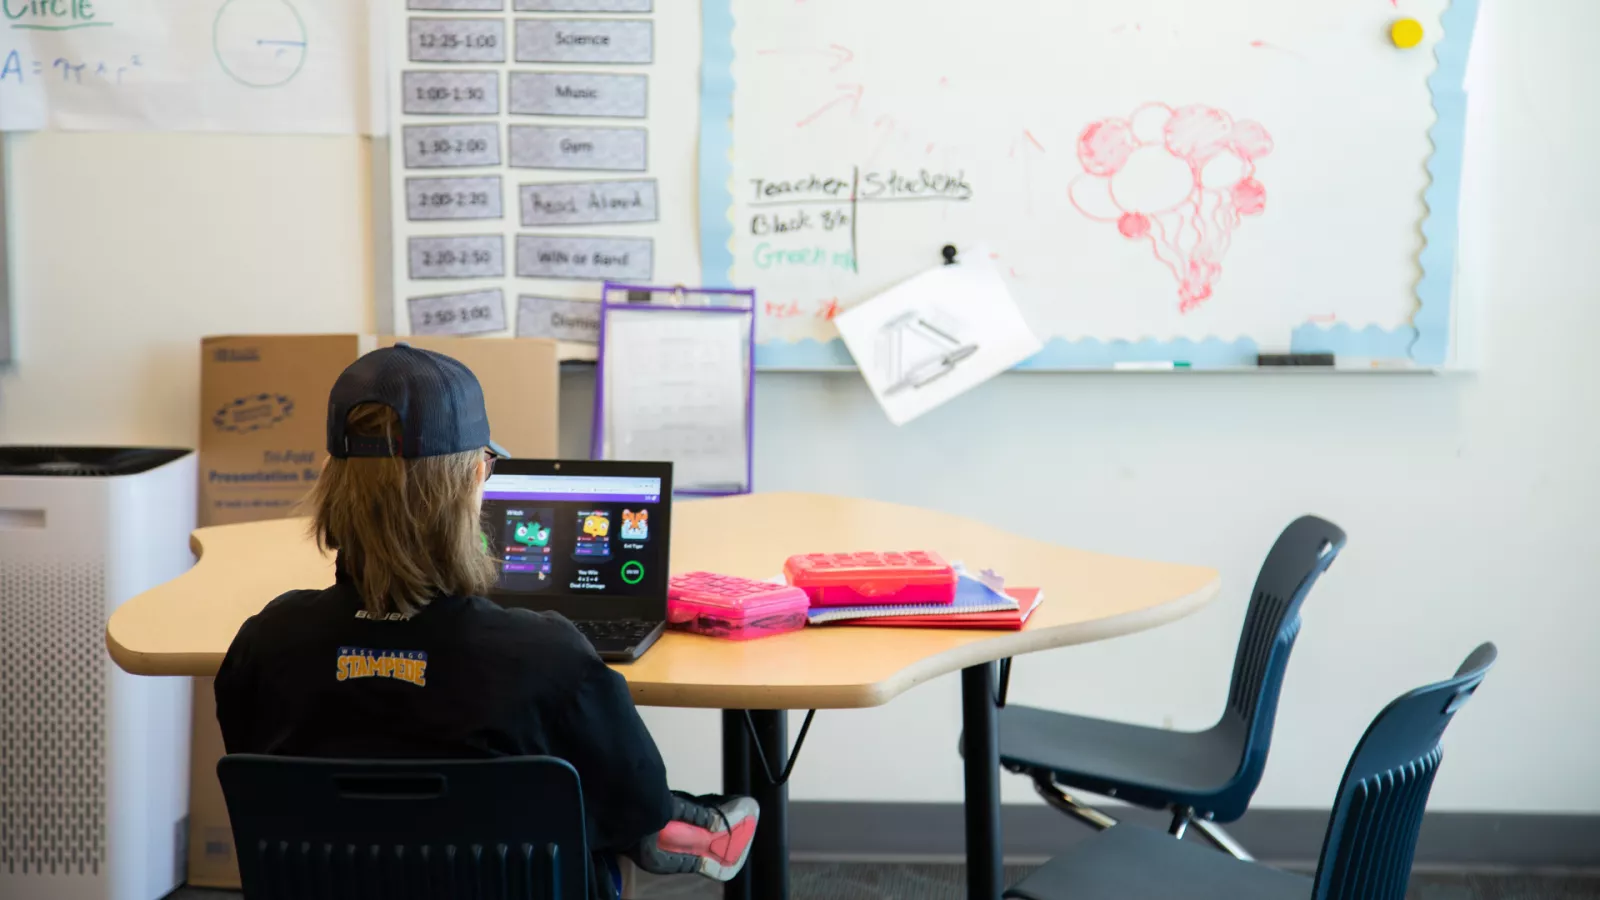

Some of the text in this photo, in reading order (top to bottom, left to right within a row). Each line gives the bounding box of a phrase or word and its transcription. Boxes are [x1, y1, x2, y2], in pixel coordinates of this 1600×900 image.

[419, 33, 497, 48] 12:25-1:00
[555, 31, 610, 47] Science
[1, 49, 23, 82] A
[416, 87, 484, 102] 1:00-1:30
[555, 86, 597, 99] Music
[418, 139, 486, 156] 1:30-2:00
[560, 138, 594, 155] Gym
[750, 173, 848, 200] Teacher
[419, 192, 488, 208] 2:00-2:20
[530, 190, 642, 214] Read Aloud
[750, 210, 814, 236] Black
[422, 250, 492, 267] 2:20-2:50
[592, 252, 630, 266] Band
[753, 243, 826, 270] Green
[208, 470, 299, 483] Presentation
[506, 509, 524, 517] Witch
[341, 648, 423, 660] WEST FARGO
[336, 655, 427, 687] STAMPEDE
